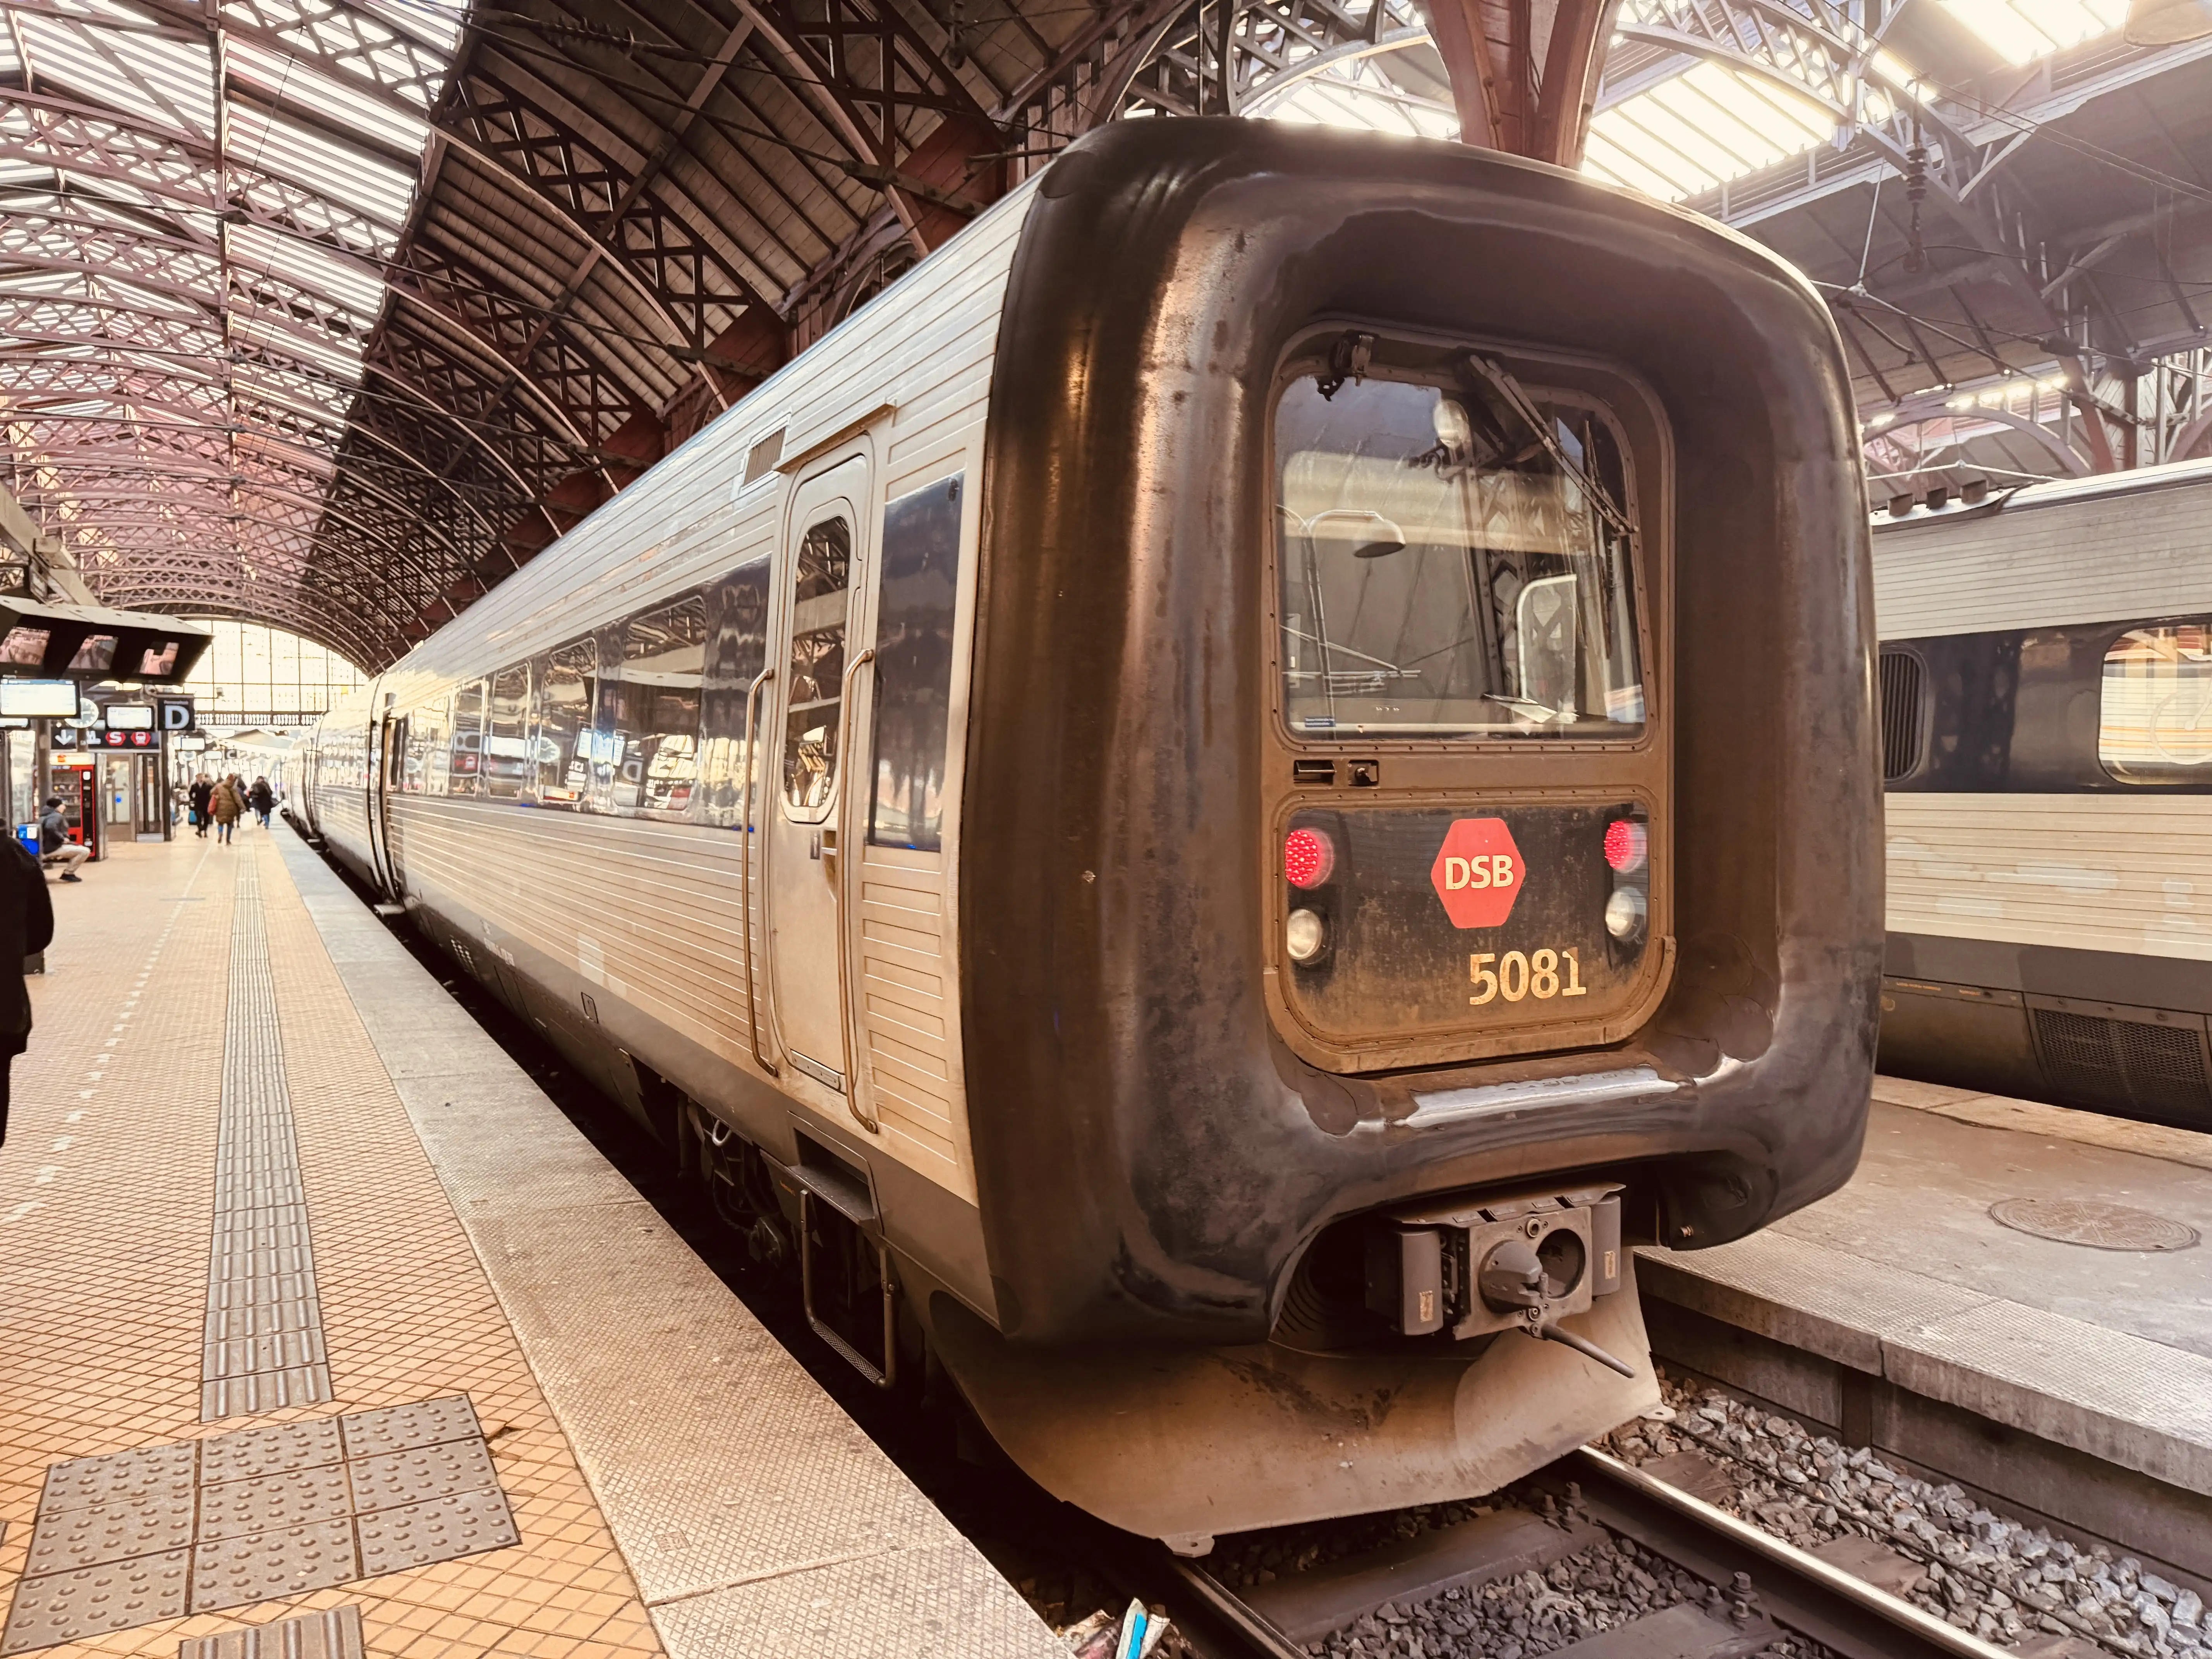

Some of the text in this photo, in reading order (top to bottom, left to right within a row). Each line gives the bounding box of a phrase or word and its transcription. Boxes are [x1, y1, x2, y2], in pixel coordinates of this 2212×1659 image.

[165, 705, 189, 729] D
[110, 732, 122, 744] S
[1445, 855, 1514, 890] DSB
[1470, 947, 1587, 1005] 5081
